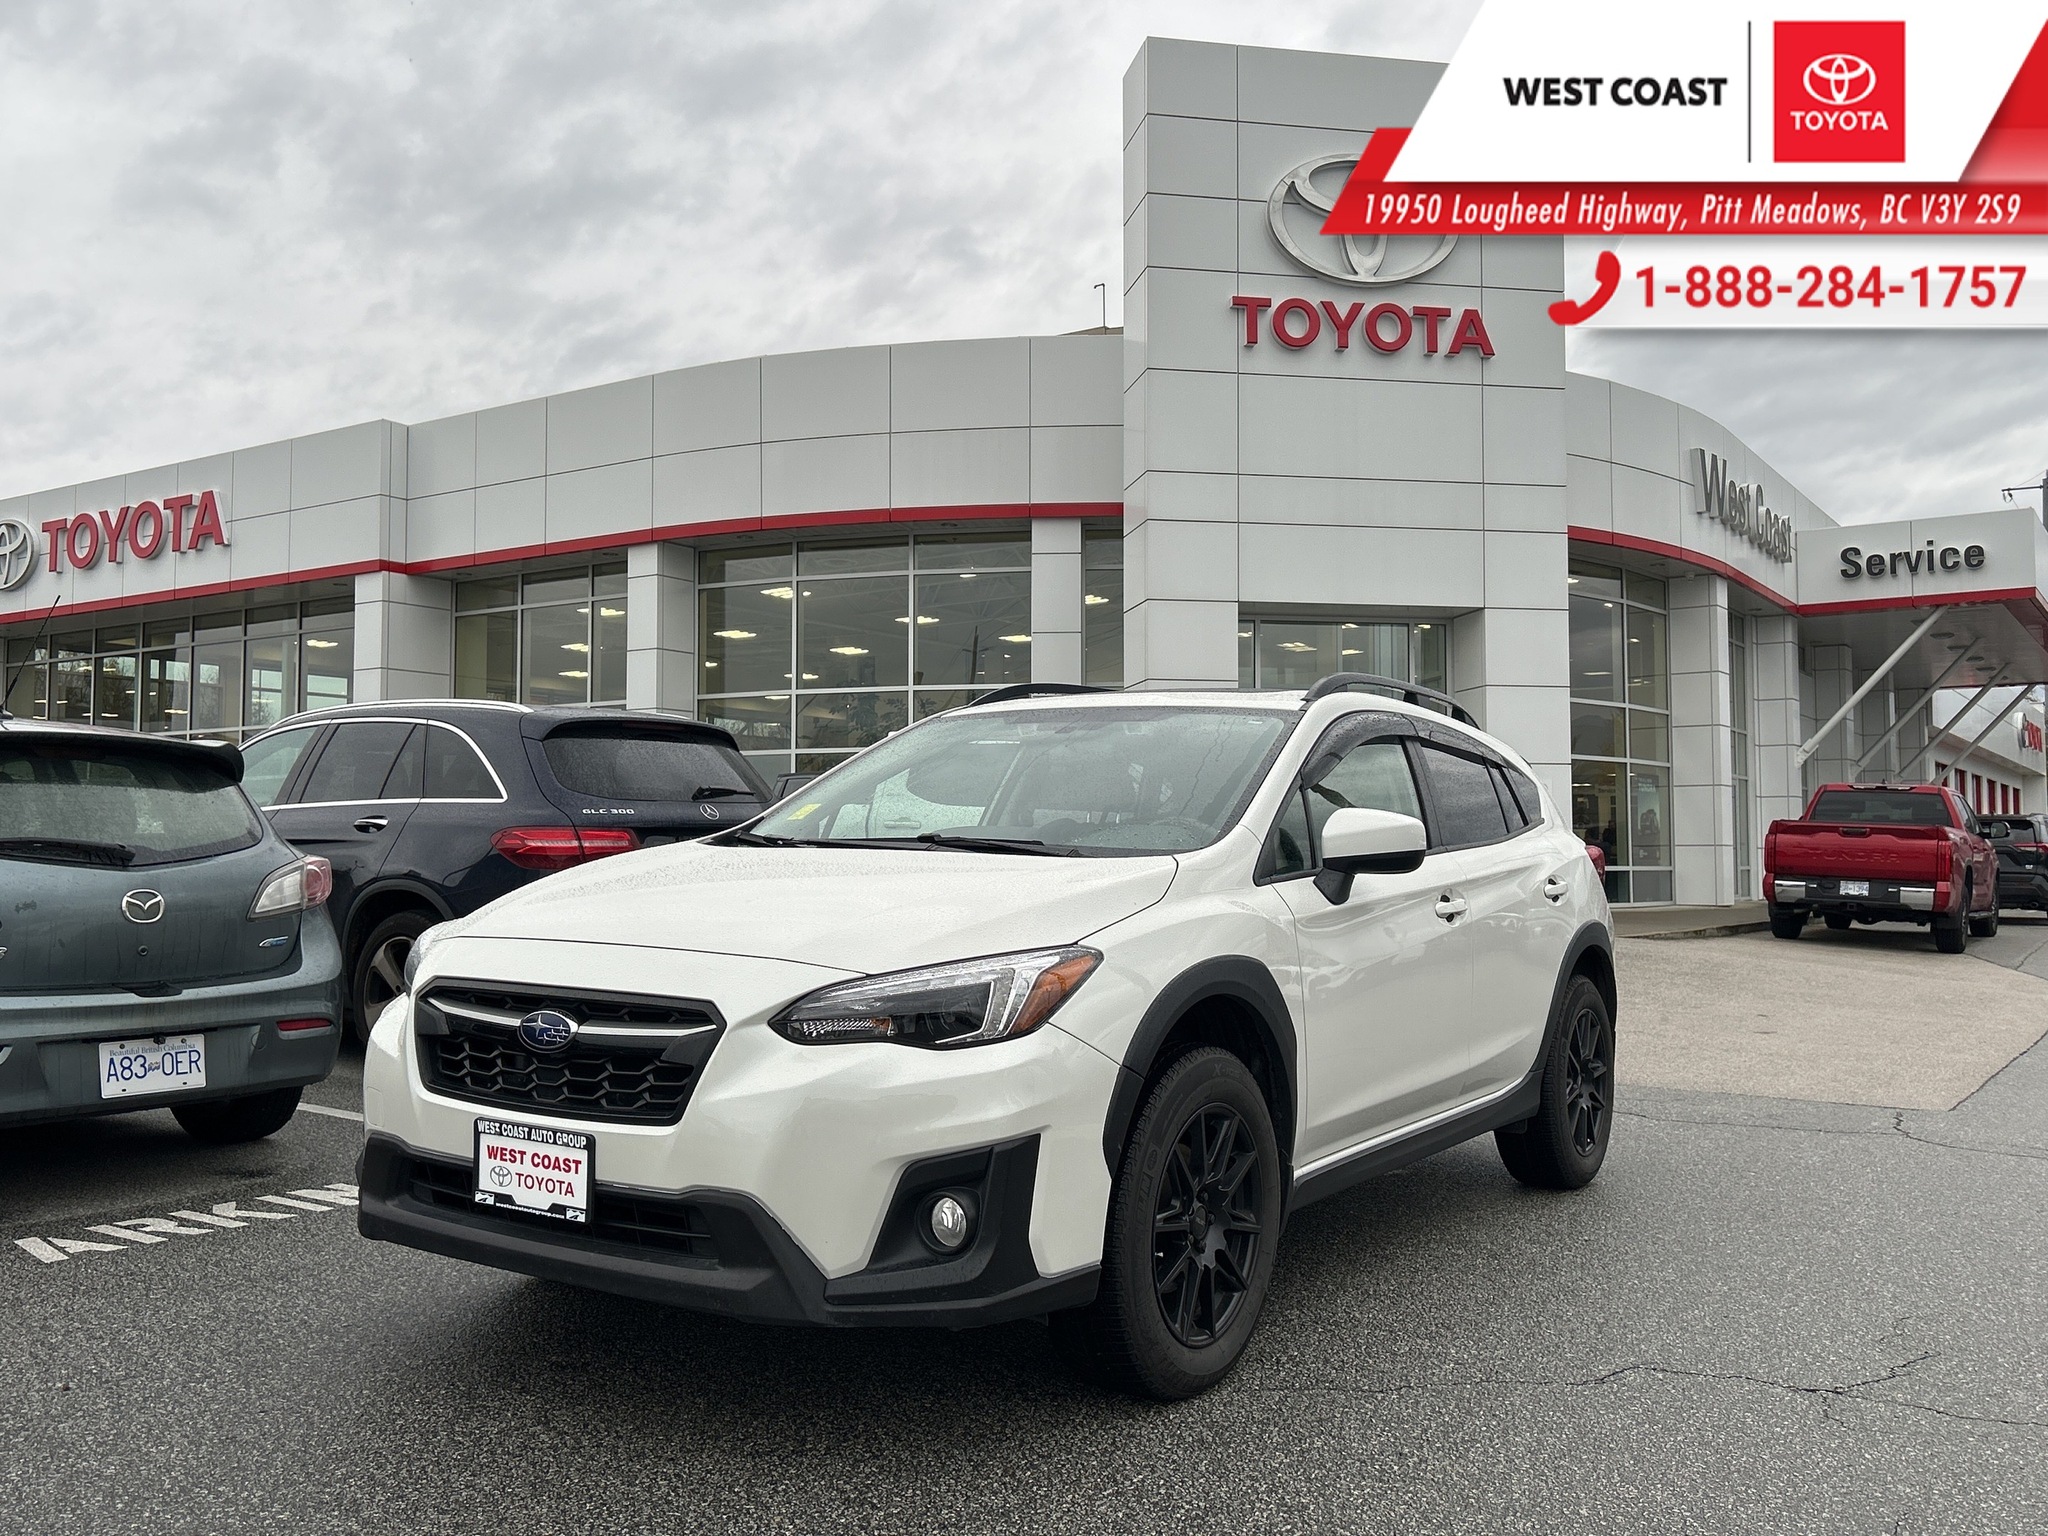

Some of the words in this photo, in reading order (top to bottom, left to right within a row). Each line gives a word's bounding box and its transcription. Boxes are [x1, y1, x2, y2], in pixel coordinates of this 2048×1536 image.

[1231, 295, 1496, 359] TOYOTA
[1690, 447, 1751, 536] West
[1750, 483, 1792, 563] Coast
[42, 489, 230, 573] TOYOTA
[1839, 539, 1986, 580] Service
[106, 1054, 147, 1083] A83
[477, 1119, 501, 1133] WEST
[501, 1123, 529, 1140] COAST
[530, 1128, 554, 1143] AUTO
[555, 1132, 587, 1149] GROUP
[486, 1144, 527, 1165] WEST
[530, 1152, 582, 1175] COAST
[515, 1172, 575, 1198] TOYOTA
